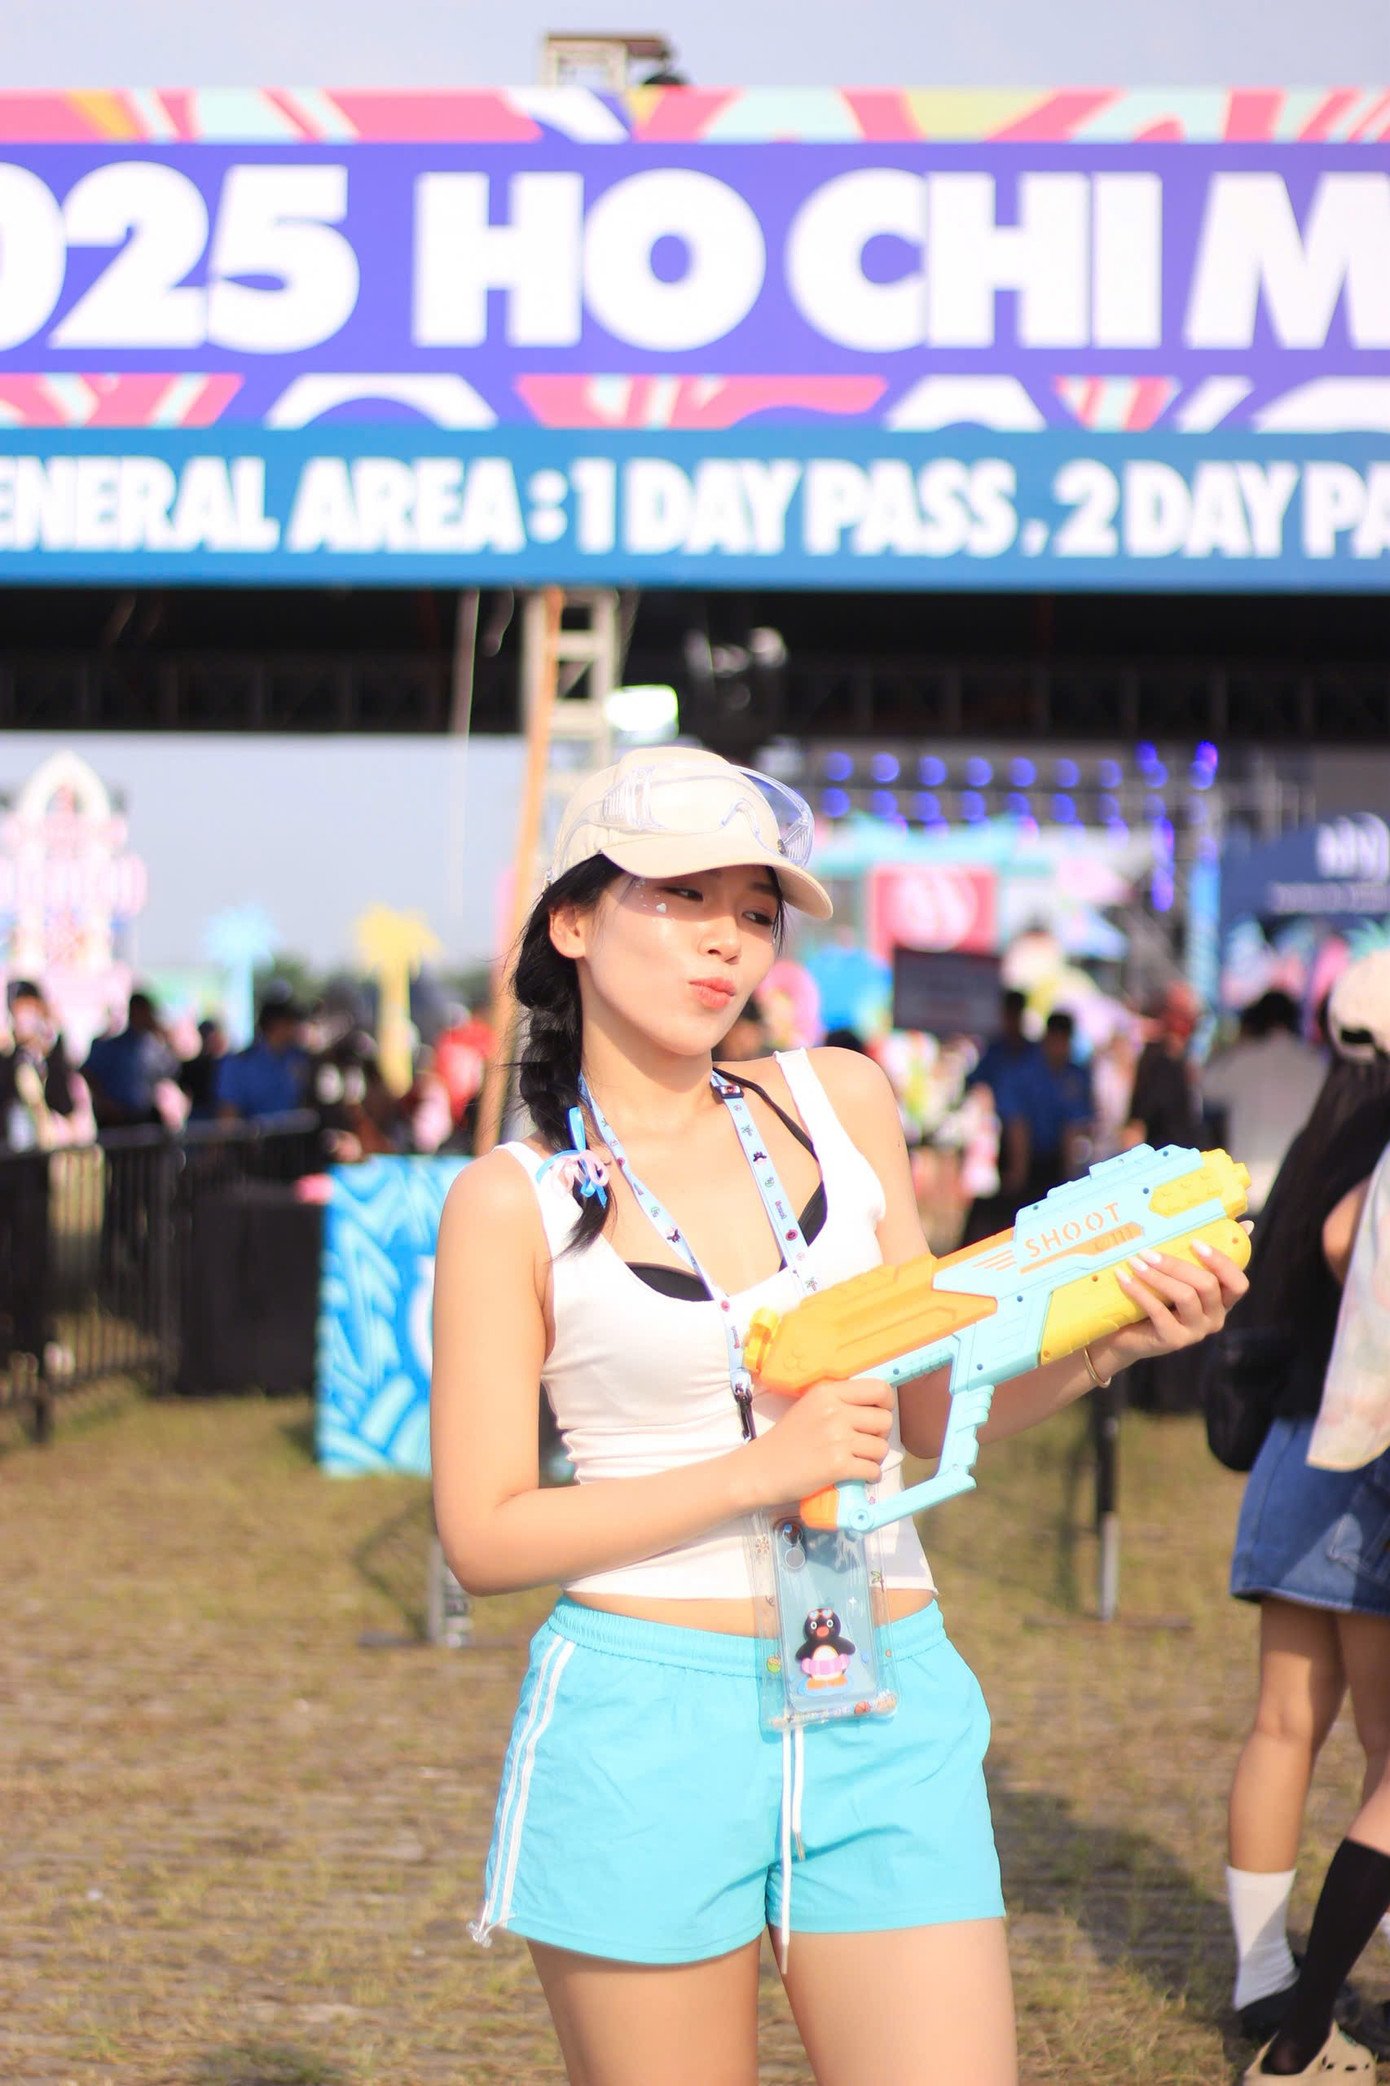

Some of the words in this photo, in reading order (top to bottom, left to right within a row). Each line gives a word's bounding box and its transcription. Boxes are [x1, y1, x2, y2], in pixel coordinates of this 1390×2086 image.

[413, 169, 765, 351] HO
[786, 168, 1162, 352] CHI
[1185, 172, 1390, 349] M
[626, 460, 800, 553] DAY
[1055, 461, 1118, 556] 2
[1125, 462, 1297, 556] DAY
[1024, 1201, 1121, 1258] SHOOT
